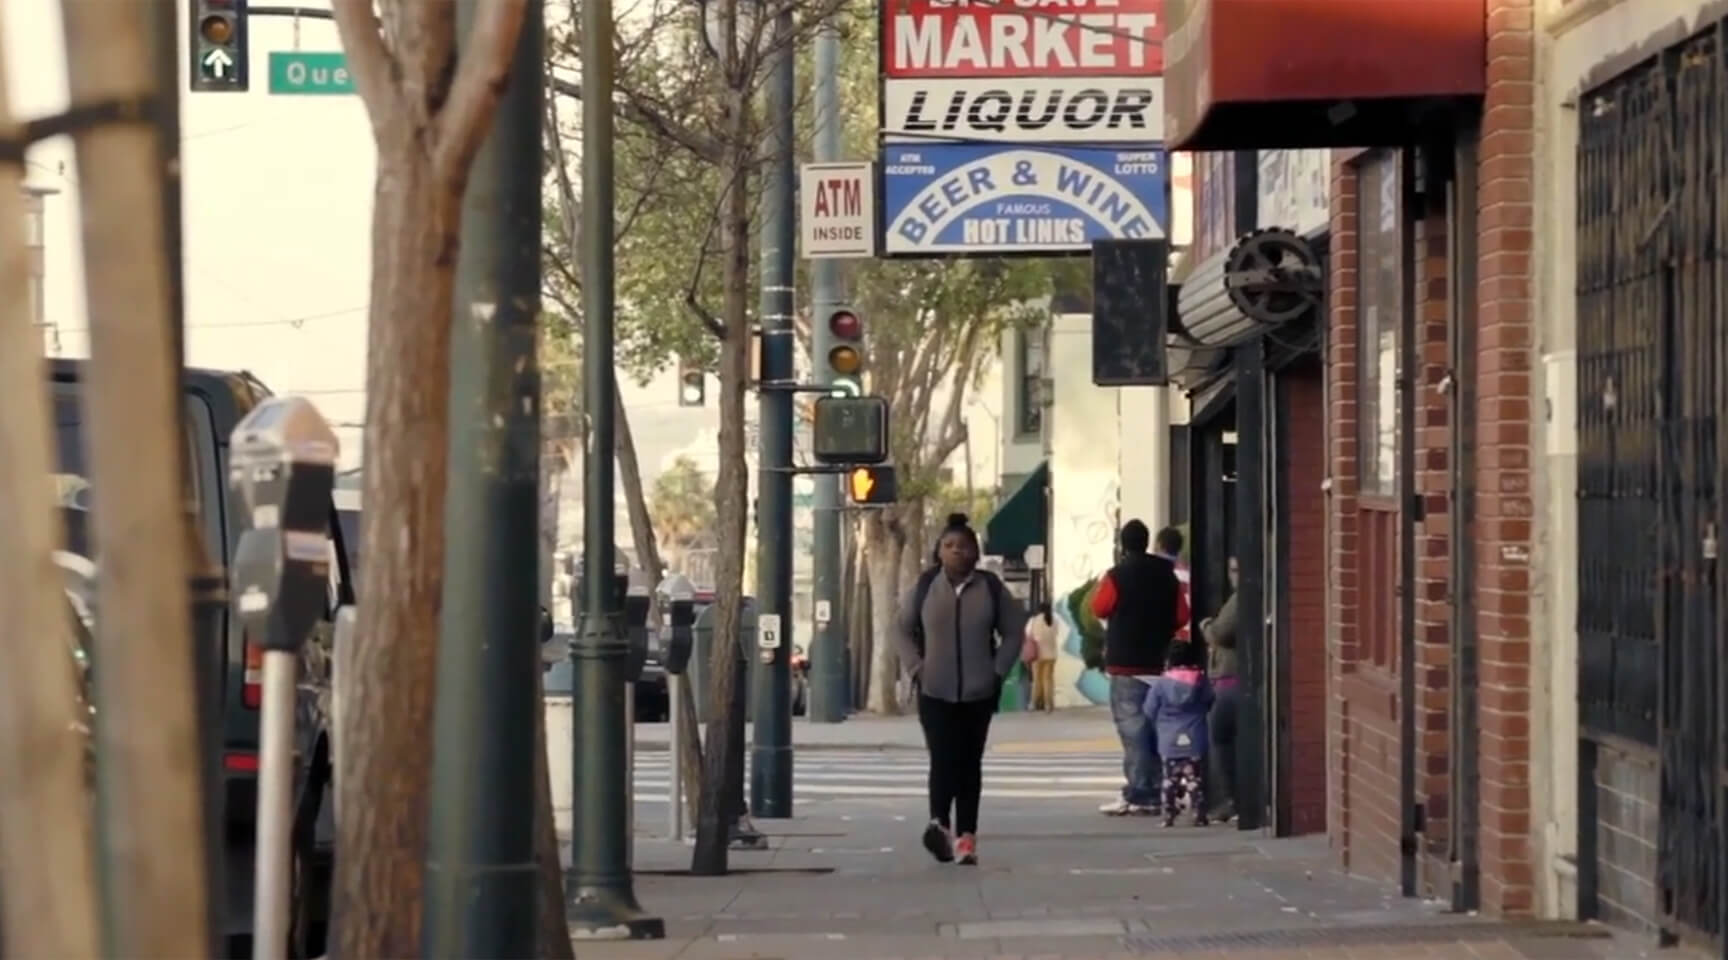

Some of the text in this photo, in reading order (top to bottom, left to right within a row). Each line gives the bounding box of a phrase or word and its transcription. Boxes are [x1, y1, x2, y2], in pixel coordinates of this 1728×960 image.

[894, 13, 1157, 69] MARKET
[903, 89, 1153, 132] LIQUOR
[1114, 163, 1158, 175] LOTTO
[1116, 152, 1156, 162] SUPER
[814, 178, 862, 217] ATM
[898, 160, 1150, 245] BEER & WINE
[996, 203, 1051, 215] FAMOUS
[813, 226, 863, 241] INSIDE
[963, 219, 1085, 243] HOT LINKS
